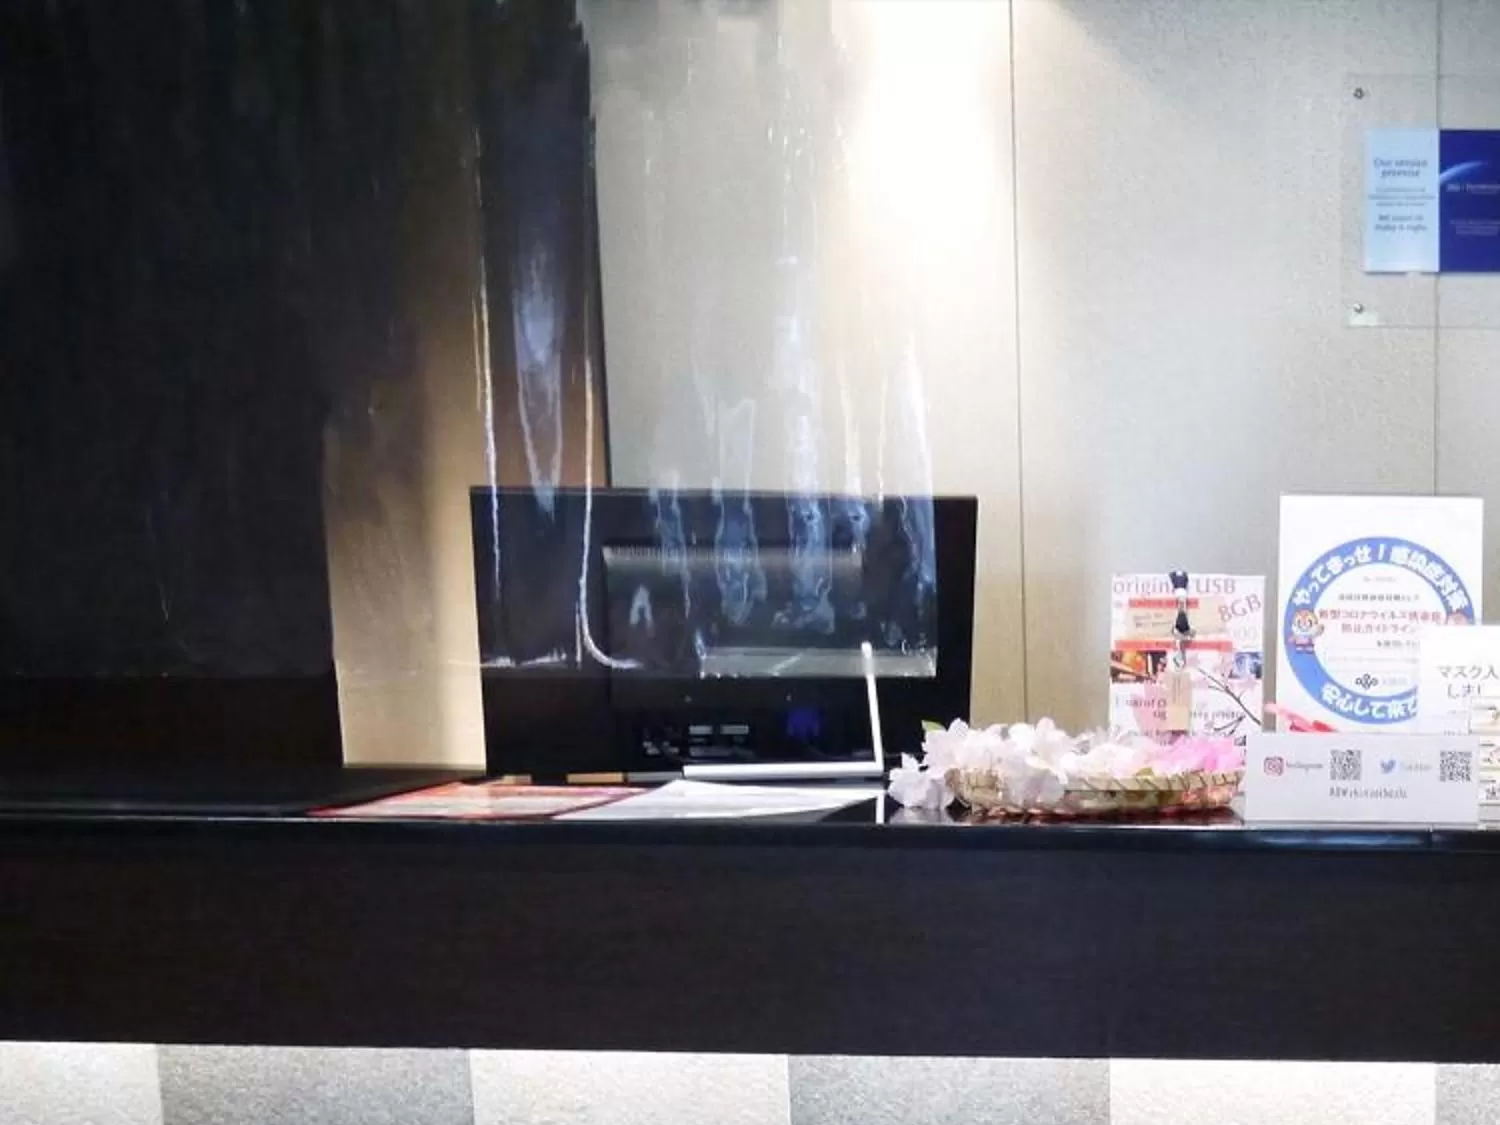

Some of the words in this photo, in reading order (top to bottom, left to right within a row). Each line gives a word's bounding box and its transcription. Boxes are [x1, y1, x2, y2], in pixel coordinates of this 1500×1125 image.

[1113, 577, 1174, 597] origin
[1196, 578, 1236, 594] USB
[1217, 594, 1261, 623] 8GB
